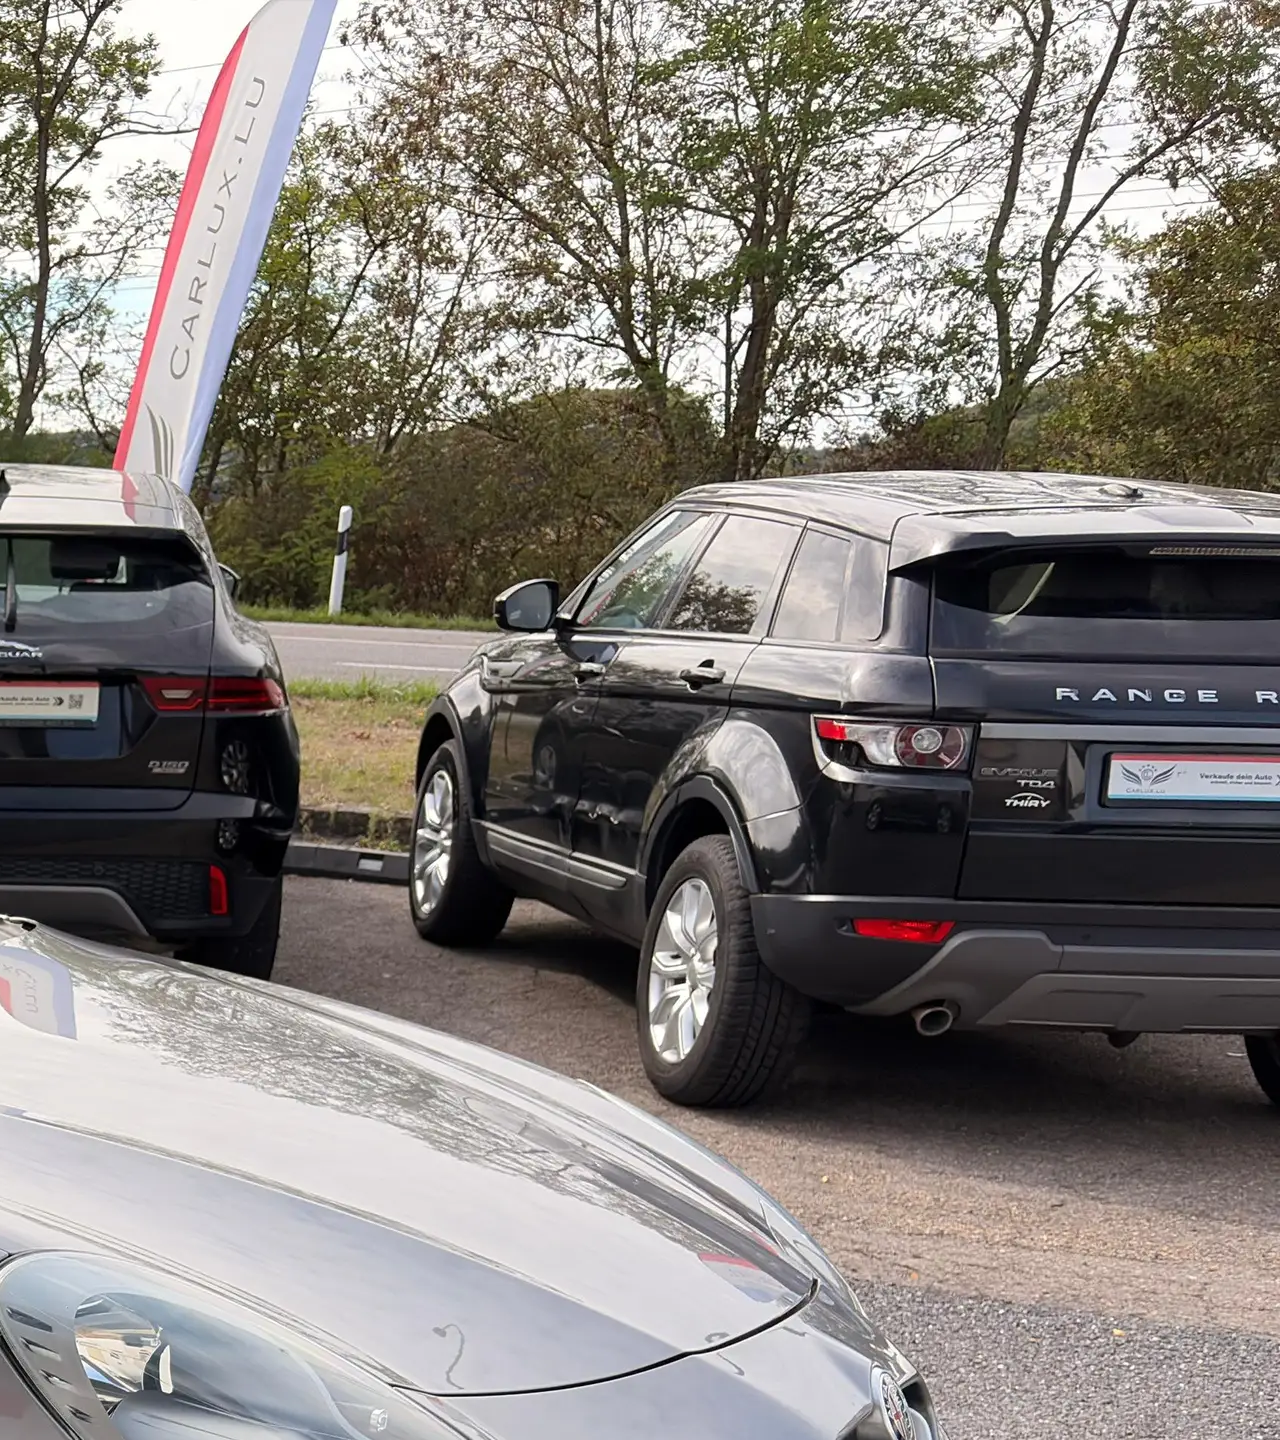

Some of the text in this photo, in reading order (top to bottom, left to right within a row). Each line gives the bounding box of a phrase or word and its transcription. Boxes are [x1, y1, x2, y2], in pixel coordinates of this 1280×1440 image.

[169, 76, 266, 380] CARLUX.LU
[1056, 687, 1219, 703] RANGE
[981, 767, 1058, 777] EVOQUE
[1017, 779, 1055, 788] TD4
